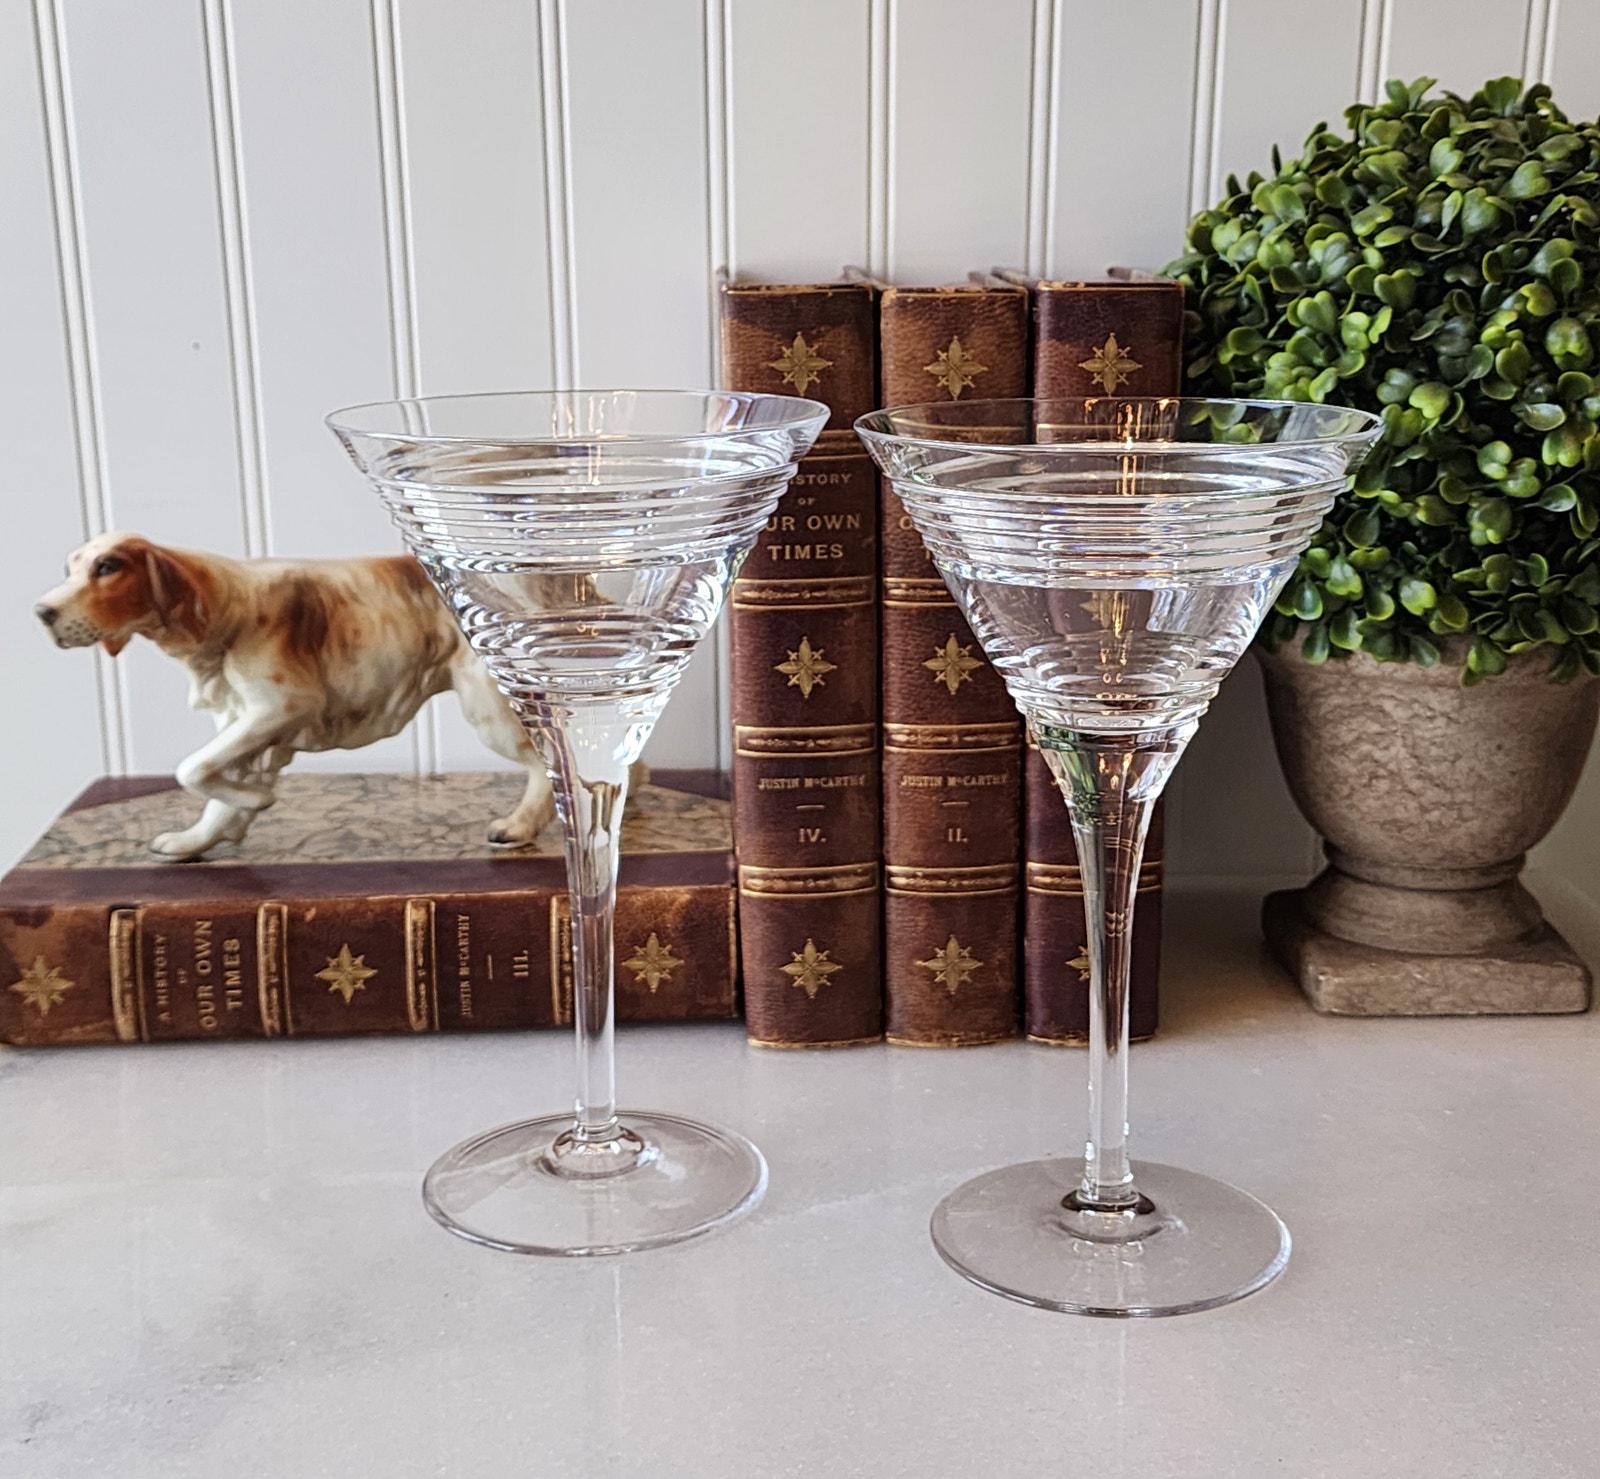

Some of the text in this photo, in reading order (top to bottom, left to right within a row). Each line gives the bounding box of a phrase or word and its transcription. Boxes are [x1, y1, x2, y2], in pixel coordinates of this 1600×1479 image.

[789, 474, 852, 485] STORY
[765, 514, 861, 532] UR OWN
[767, 544, 843, 560] TIMES
[758, 778, 799, 790] JUSTIN
[900, 775, 942, 787] JUSTIN
[799, 828, 827, 842] IV.
[155, 935, 169, 1006] HISTORY
[513, 949, 529, 977] III.
[194, 920, 217, 1029] OUR OWN
[223, 938, 242, 1009] TIMES
